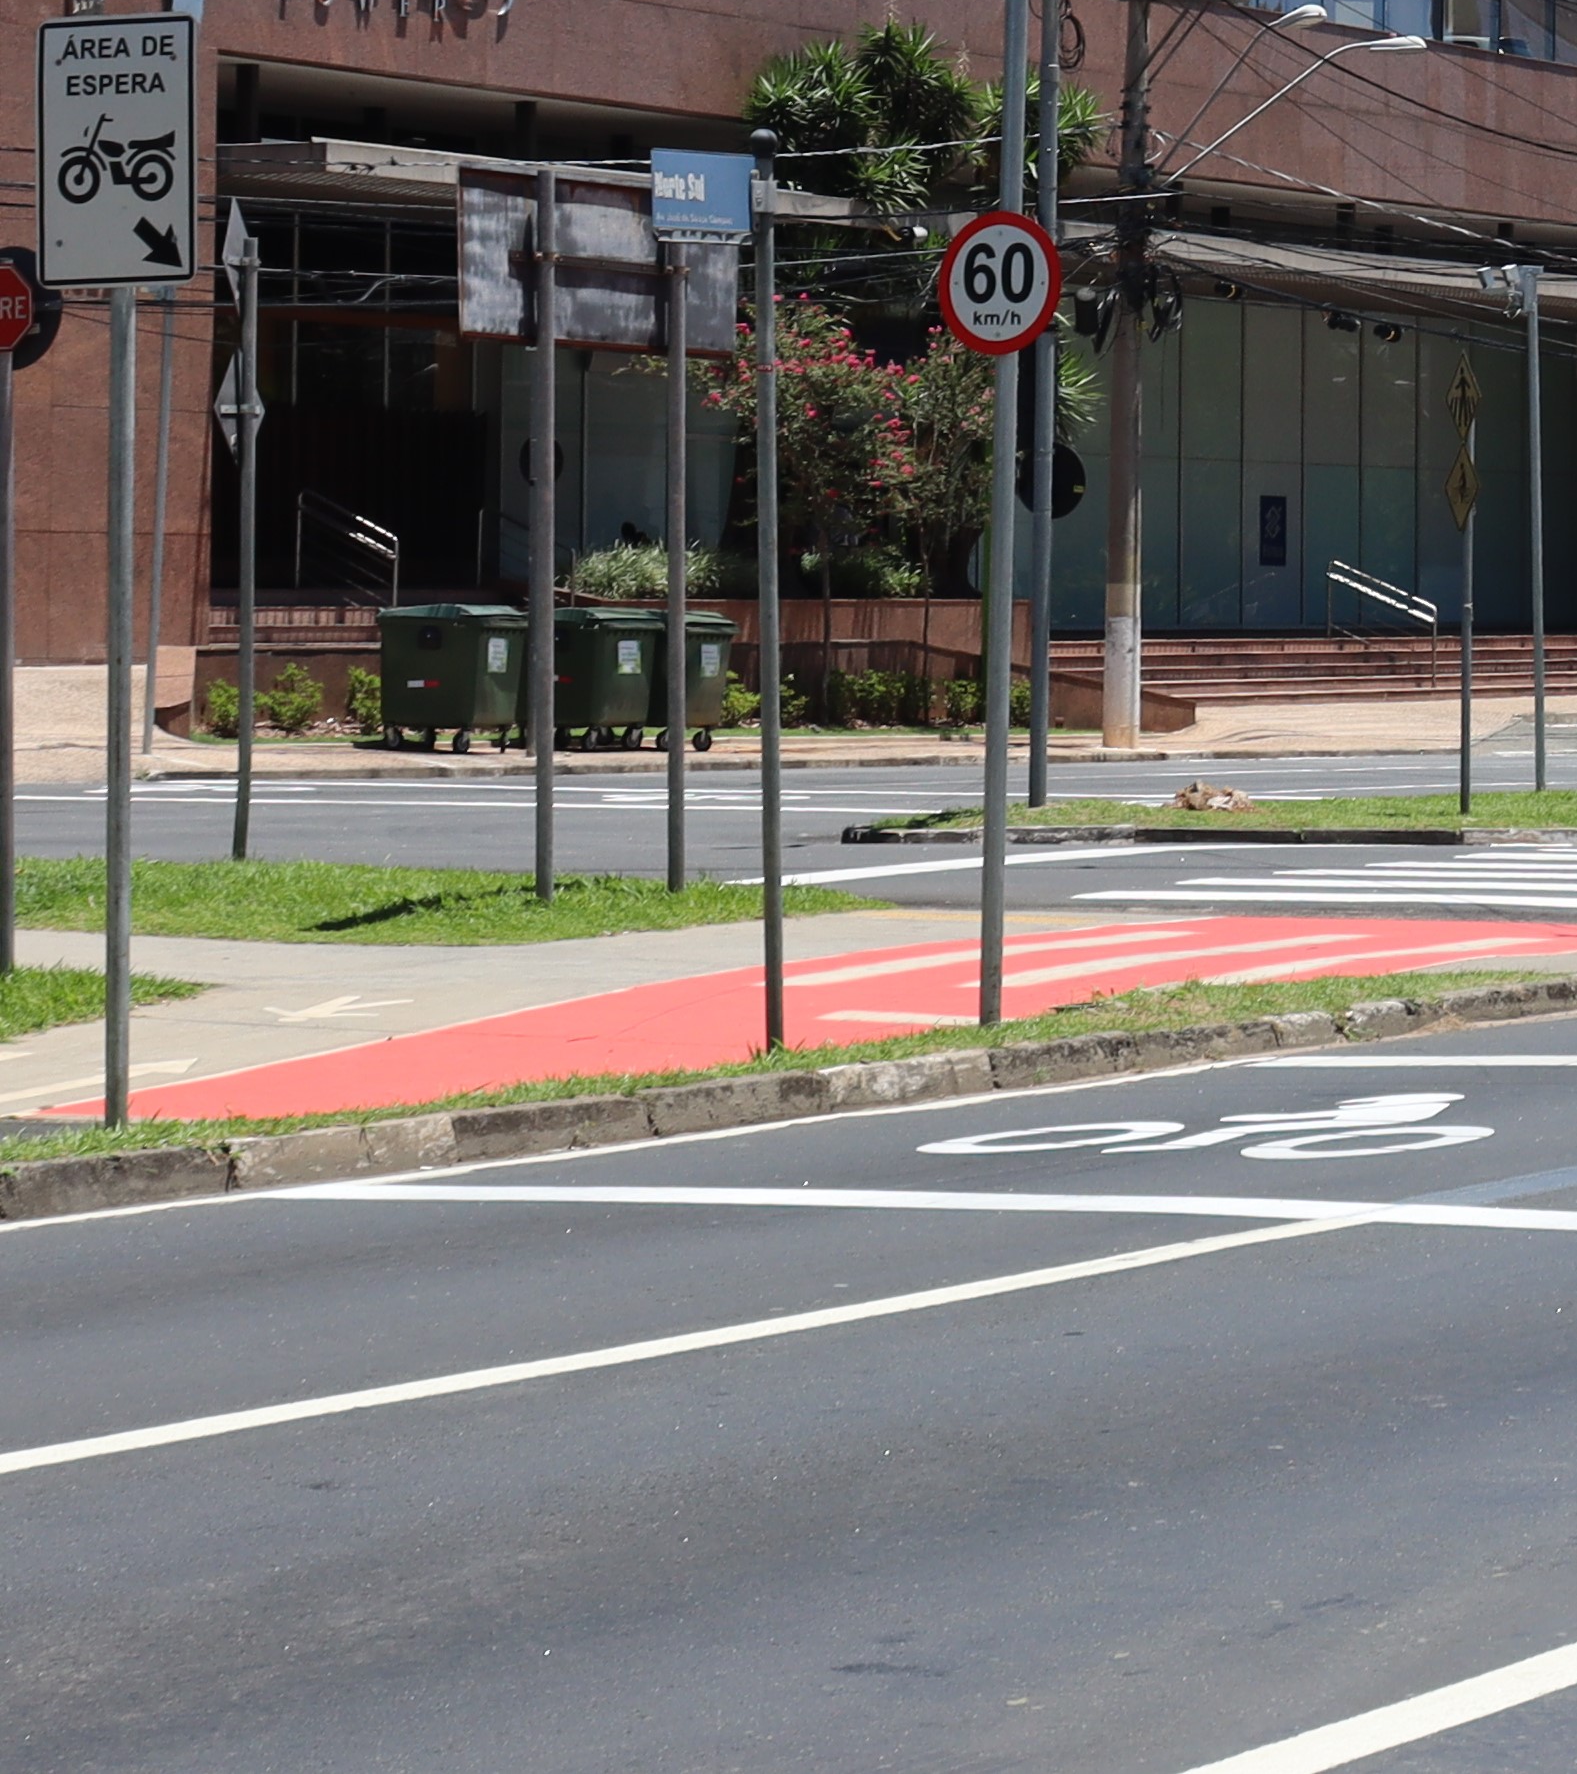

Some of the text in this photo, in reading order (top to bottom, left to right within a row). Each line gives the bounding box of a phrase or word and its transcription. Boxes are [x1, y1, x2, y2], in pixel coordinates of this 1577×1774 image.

[62, 35, 175, 59] ÁREA DE
[66, 73, 166, 97] ESPERA
[964, 242, 1034, 304] 60
[973, 309, 1021, 327] km/h
